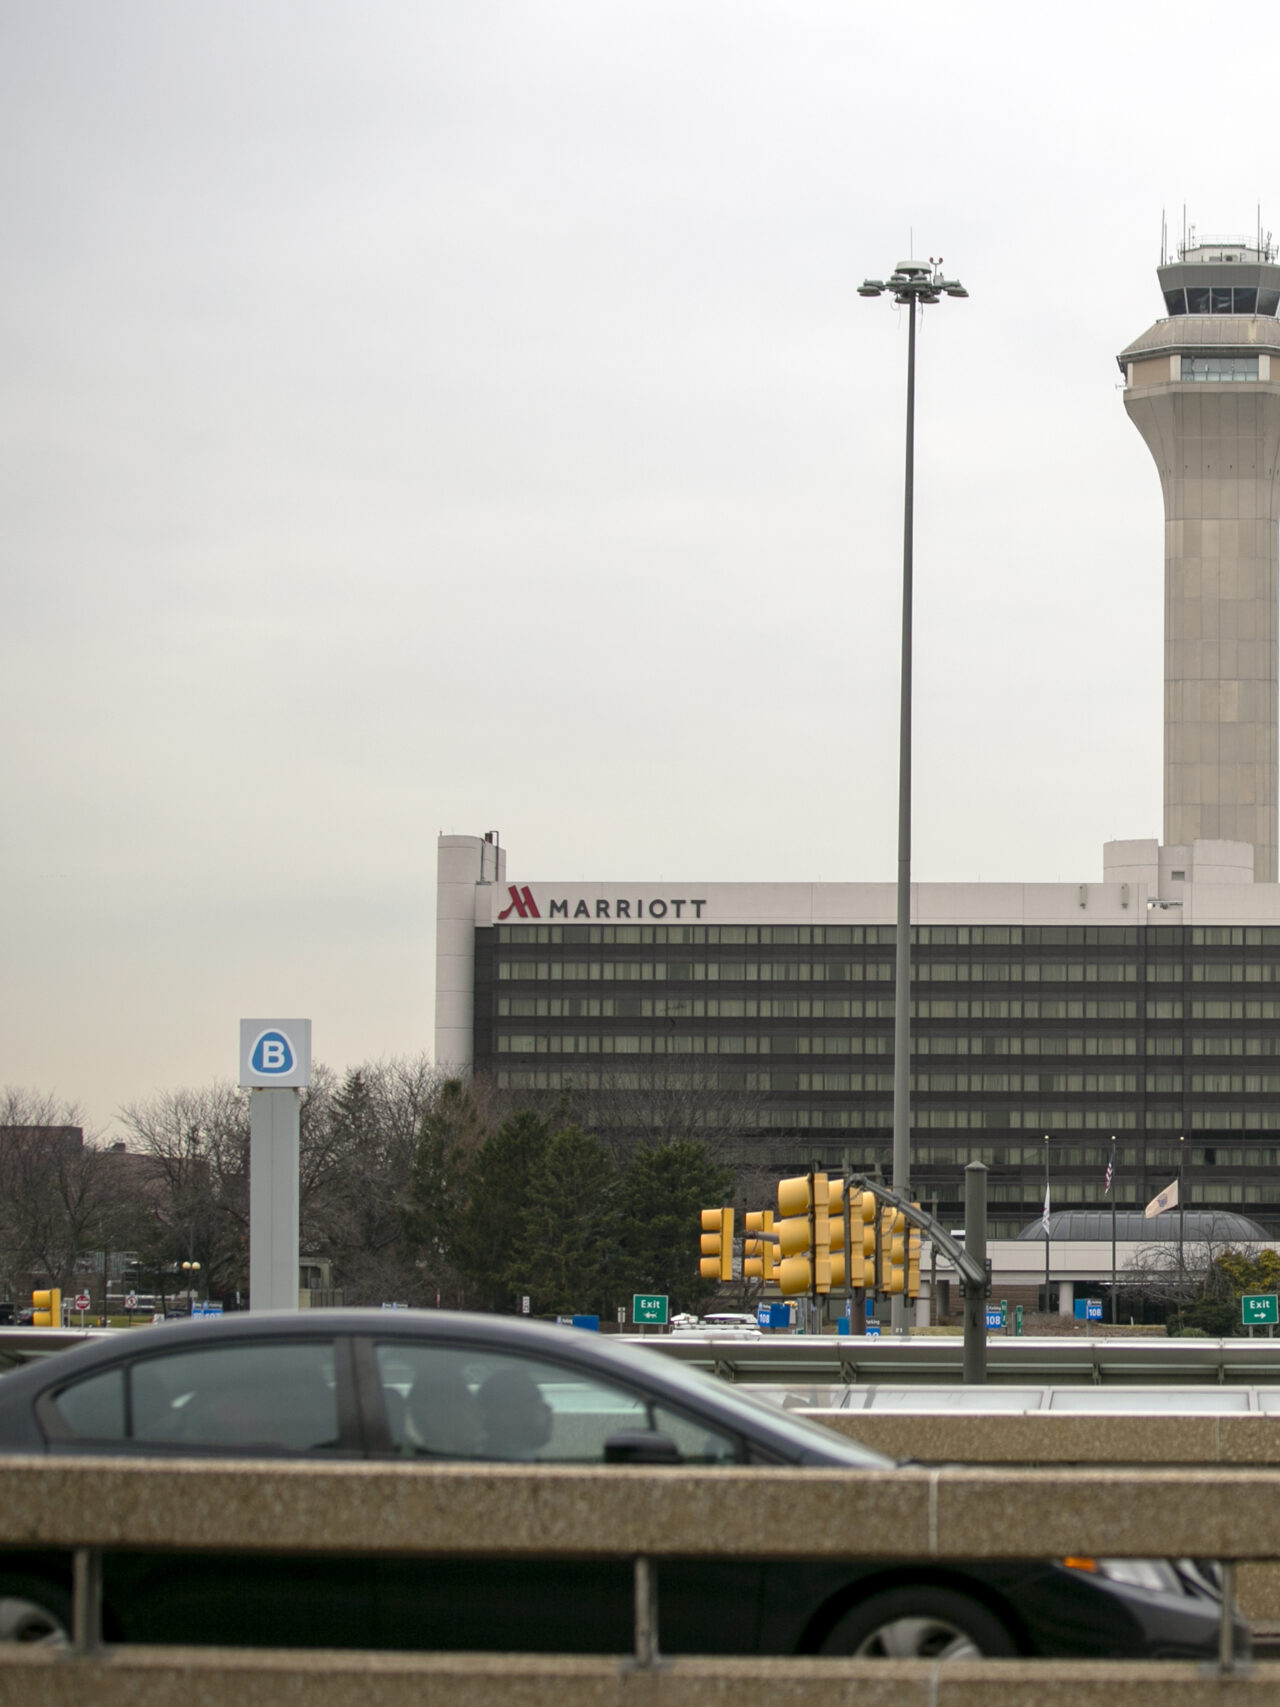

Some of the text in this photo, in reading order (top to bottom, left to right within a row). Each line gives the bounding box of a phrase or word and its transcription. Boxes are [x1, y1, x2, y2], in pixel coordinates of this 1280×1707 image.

[549, 898, 707, 919] MARRIOTT
[263, 1040, 285, 1068] B
[640, 1299, 660, 1309] Exit
[1249, 1299, 1271, 1309] Exit
[986, 1315, 1001, 1326] 108
